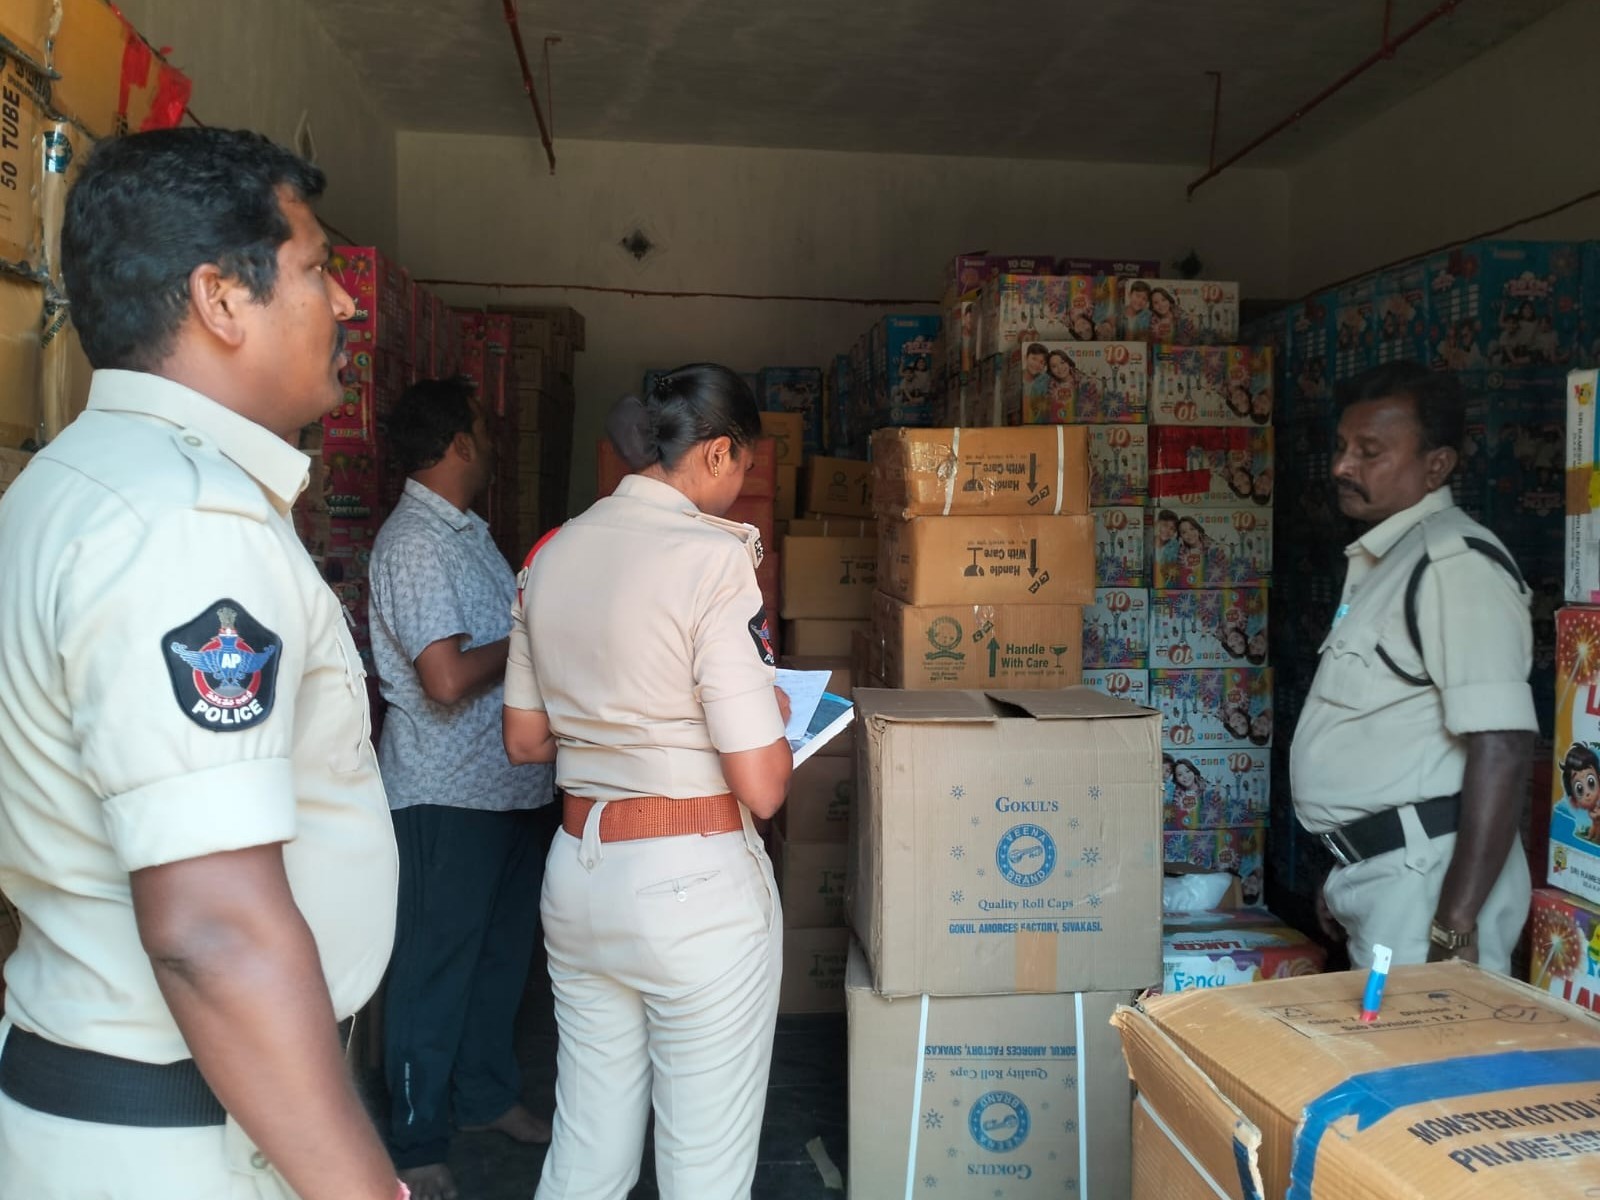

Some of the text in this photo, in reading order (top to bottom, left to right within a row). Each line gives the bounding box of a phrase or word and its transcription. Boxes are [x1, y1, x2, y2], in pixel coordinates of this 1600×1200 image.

[1, 86, 20, 190] 50 TUBE
[1105, 345, 1125, 363] 10
[1177, 403, 1197, 421] 10
[1107, 428, 1127, 447] 10
[1104, 510, 1124, 528] 10
[1233, 511, 1253, 530] 10
[984, 549, 1026, 577] Handle With Care
[1106, 591, 1127, 610] 10
[1006, 643, 1046, 655] Handle
[1172, 648, 1194, 665] 10
[221, 653, 242, 669] AP
[1001, 657, 1049, 668] With Care
[1106, 673, 1127, 692] 10
[192, 698, 264, 724] POLICE
[1173, 729, 1195, 745] 10
[1229, 753, 1250, 771] 10
[1006, 827, 1046, 842] VEENA
[1006, 869, 1046, 885] BRAND
[978, 898, 1074, 912] Quality Roll Caps
[949, 923, 976, 934] GOKUL
[978, 922, 1018, 934] AMORCES
[1172, 941, 1242, 950] LANCER
[964, 1043, 1004, 1056] FACTORY,
[1006, 1046, 1047, 1056] AMORCES
[1050, 1046, 1077, 1056] GOKUL
[949, 1066, 1048, 1081] Quality Roll Caps
[980, 1093, 1020, 1108] BRAND
[1407, 1109, 1519, 1146] MONSTER
